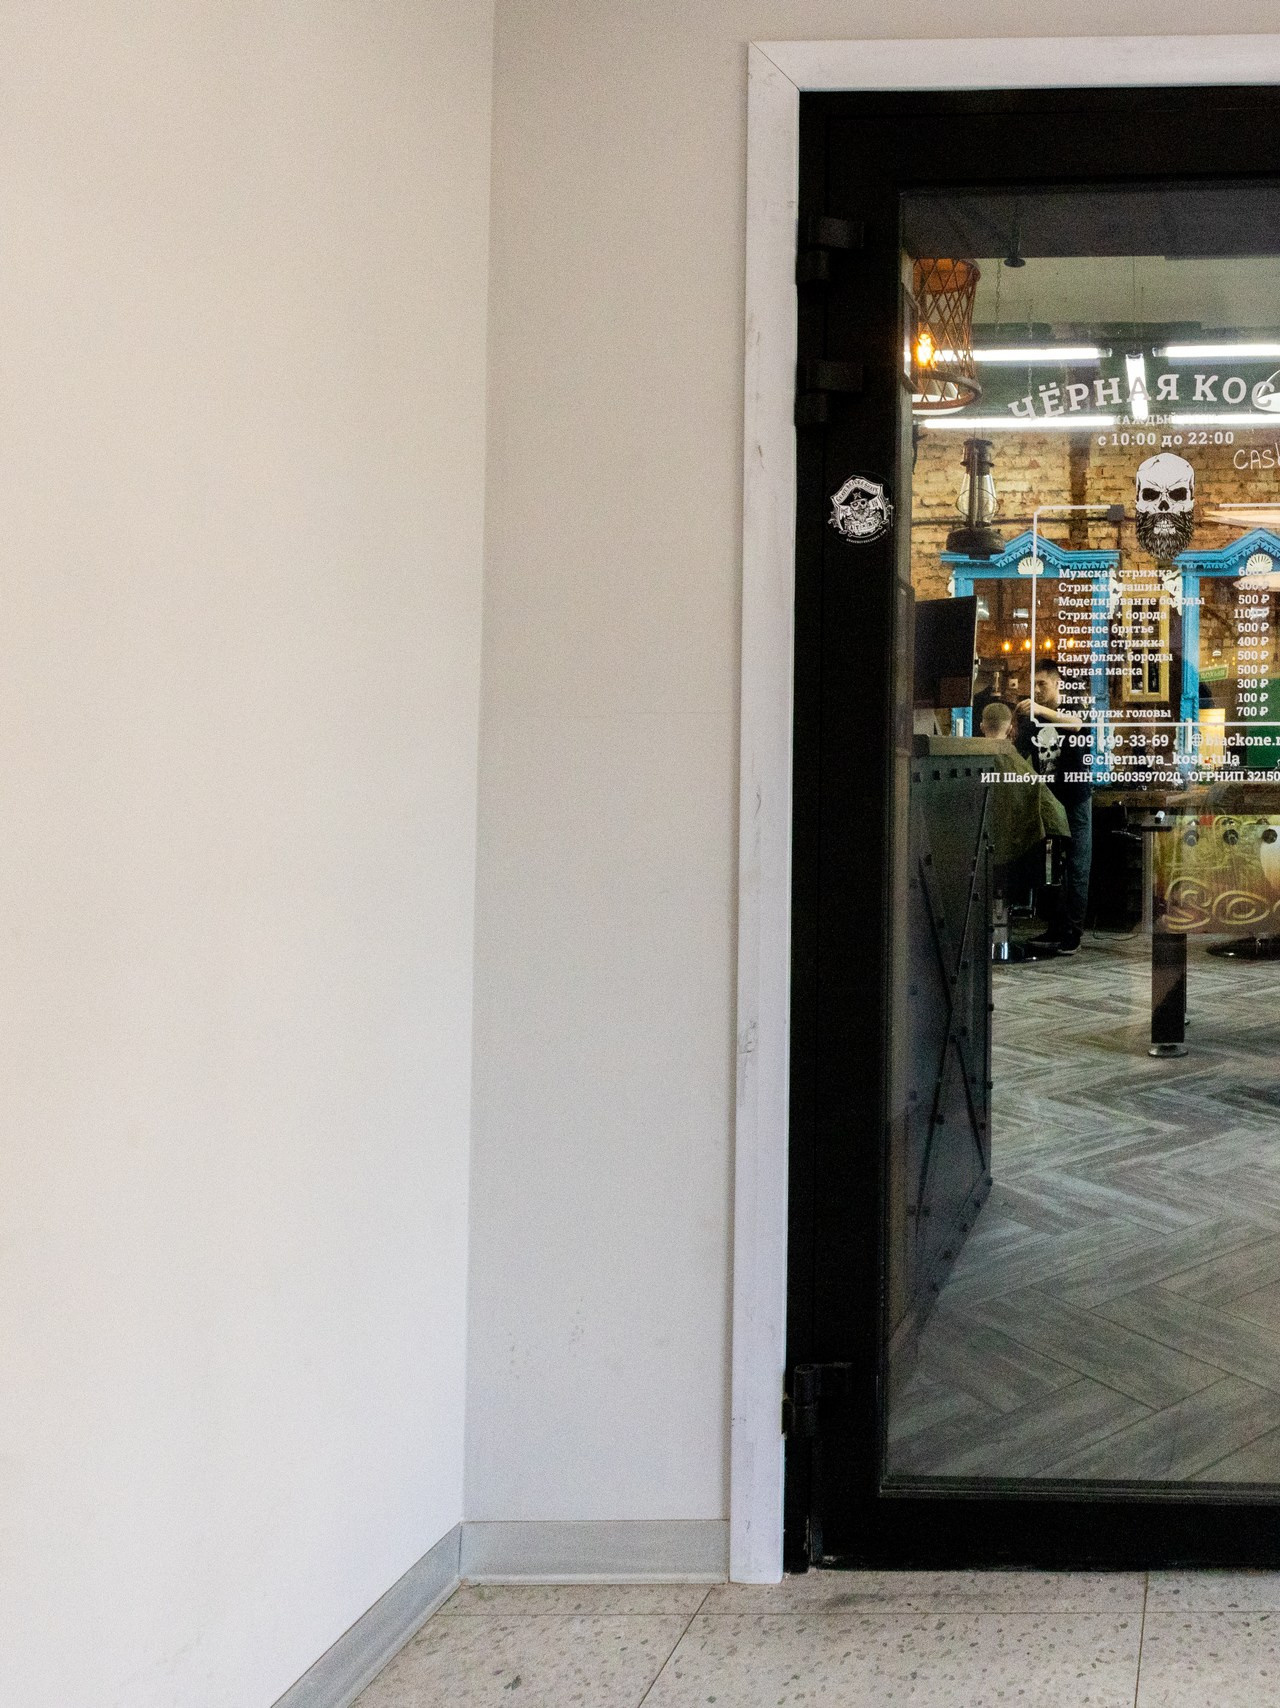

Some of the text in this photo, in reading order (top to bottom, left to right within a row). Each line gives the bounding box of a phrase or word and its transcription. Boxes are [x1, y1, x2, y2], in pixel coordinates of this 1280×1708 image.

[1008, 373, 1180, 420] ЧЁРНАЯ
[1098, 431, 1235, 448] с 10:00 до 22:00
[1059, 569, 1117, 580] Мужская
[1118, 569, 1173, 581] стрижка
[1058, 596, 1157, 607] Моделирование
[1238, 594, 1258, 604] 500
[1058, 610, 1113, 622] Стрижка
[1125, 610, 1167, 622] борода
[1058, 624, 1109, 634] Опасное
[1111, 624, 1154, 637] бритье
[1237, 622, 1258, 632] 600
[1057, 638, 1108, 650] Дтская
[1111, 638, 1165, 651] стрижка
[1237, 636, 1258, 646] 400
[1057, 652, 1125, 664] Камуфляж
[1126, 651, 1173, 663] бороды
[1237, 650, 1258, 660] 500
[1057, 666, 1102, 678] Черная
[1105, 666, 1143, 676] маска
[1237, 664, 1258, 674] 500
[1057, 680, 1087, 690] Воск
[1236, 678, 1258, 689] 300
[1056, 694, 1096, 704] Патчи
[1237, 692, 1258, 703] 100
[1056, 708, 1124, 720] Камуфляж
[1125, 708, 1172, 718] головы
[1236, 706, 1257, 717] 700
[1068, 734, 1094, 747] 909
[980, 772, 1000, 783] ИП
[1003, 772, 1055, 786] Шабуня
[1063, 772, 1093, 783] ИНН
[1189, 771, 1244, 782] ОГРНИП
